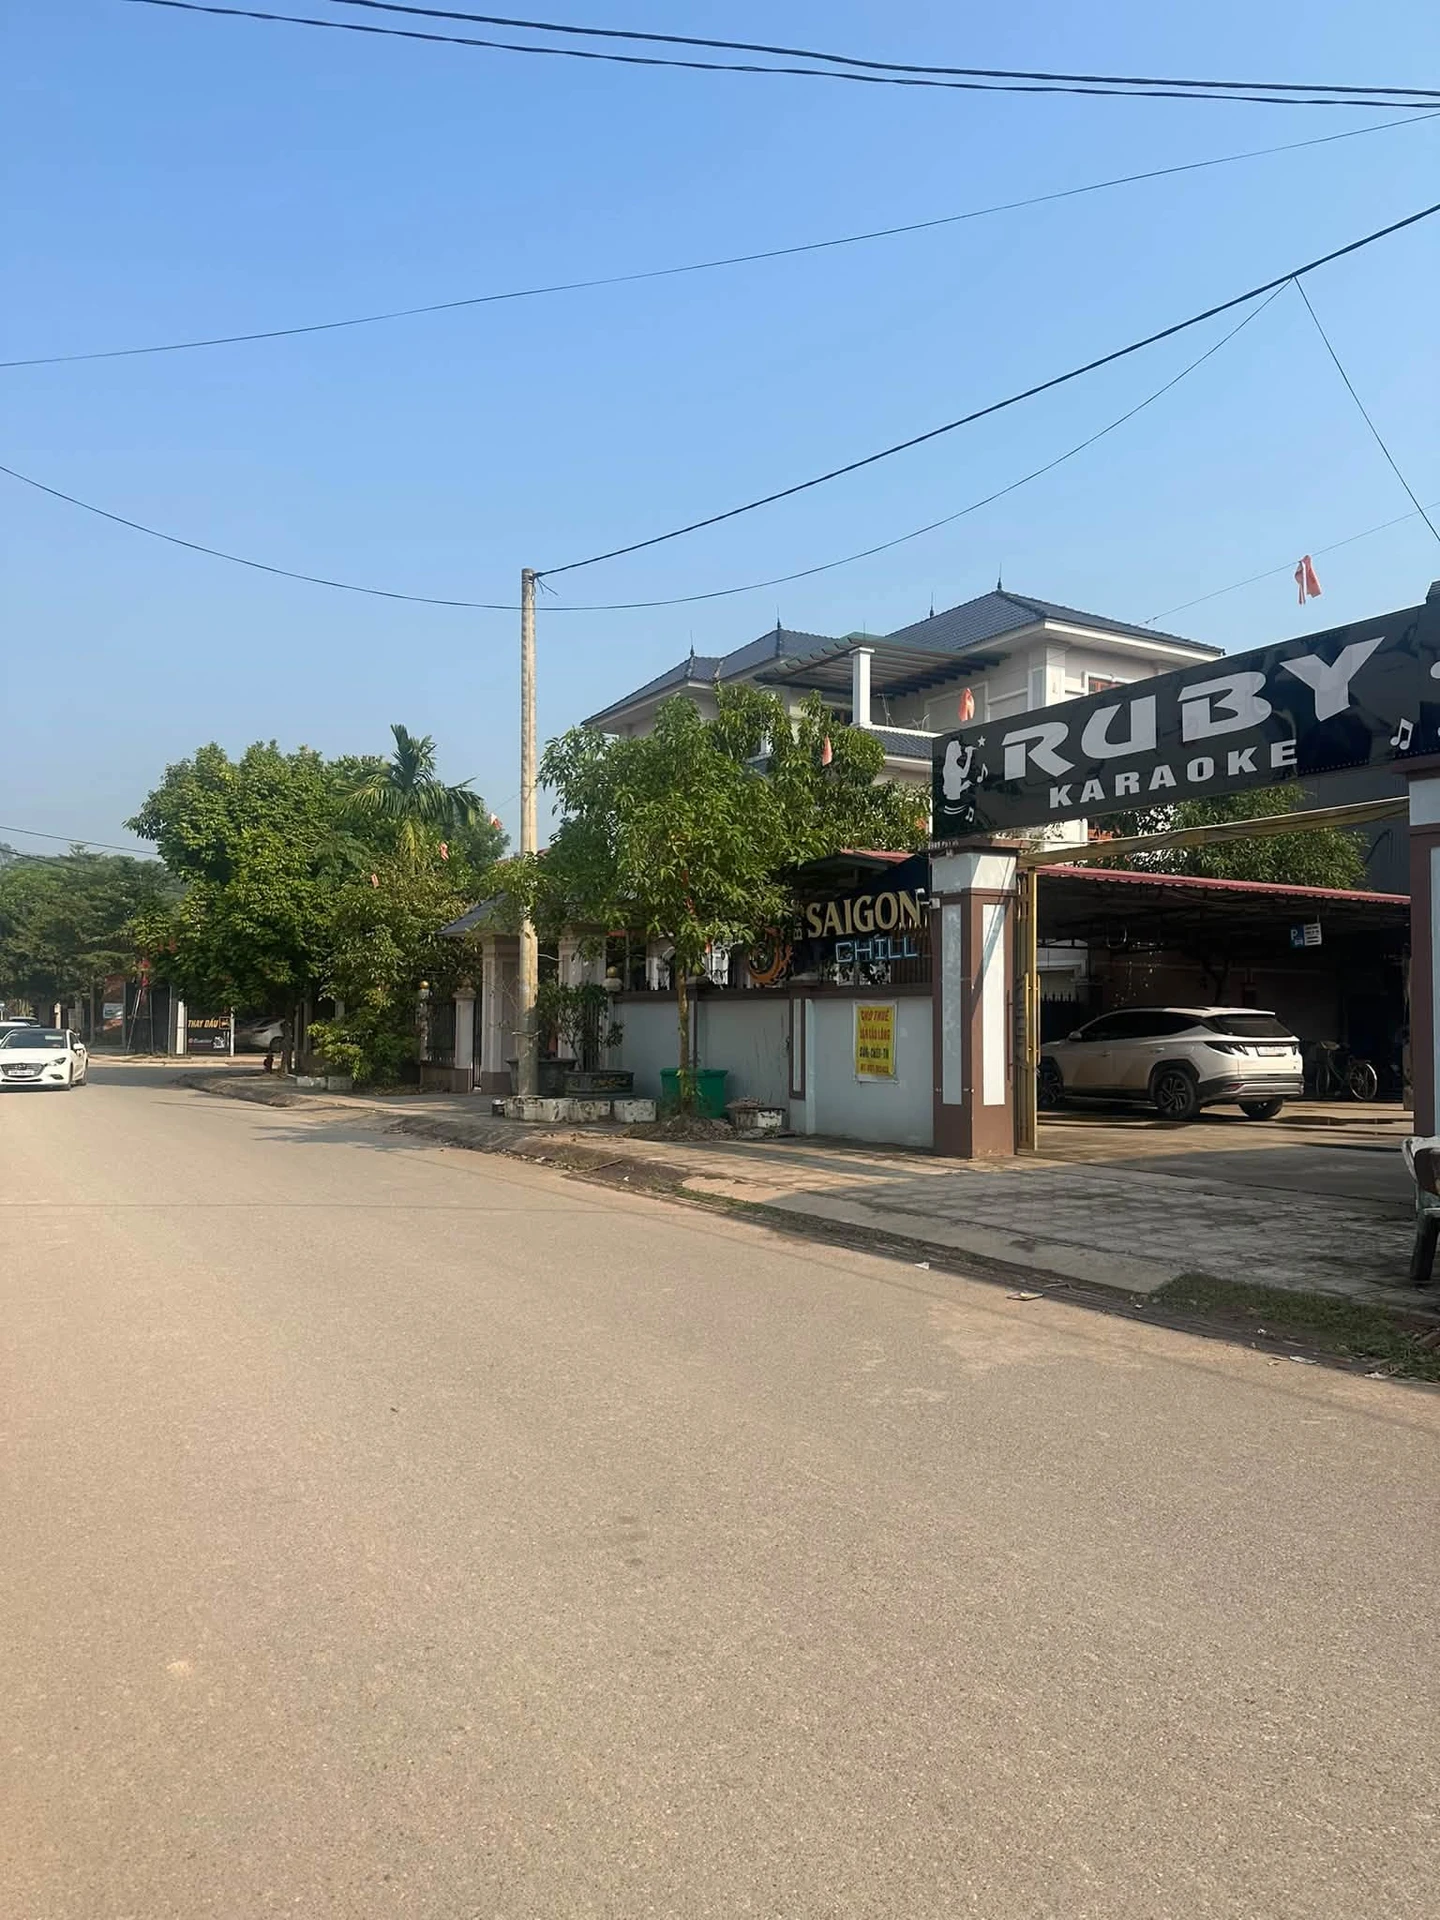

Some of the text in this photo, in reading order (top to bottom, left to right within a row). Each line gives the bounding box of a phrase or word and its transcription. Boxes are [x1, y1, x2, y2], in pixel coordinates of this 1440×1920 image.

[1001, 636, 1386, 781] RUBY
[1049, 739, 1298, 809] KARAOKE
[806, 890, 922, 939] SAIGON
[835, 935, 918, 962] CHILL
[187, 1019, 204, 1028] THAY
